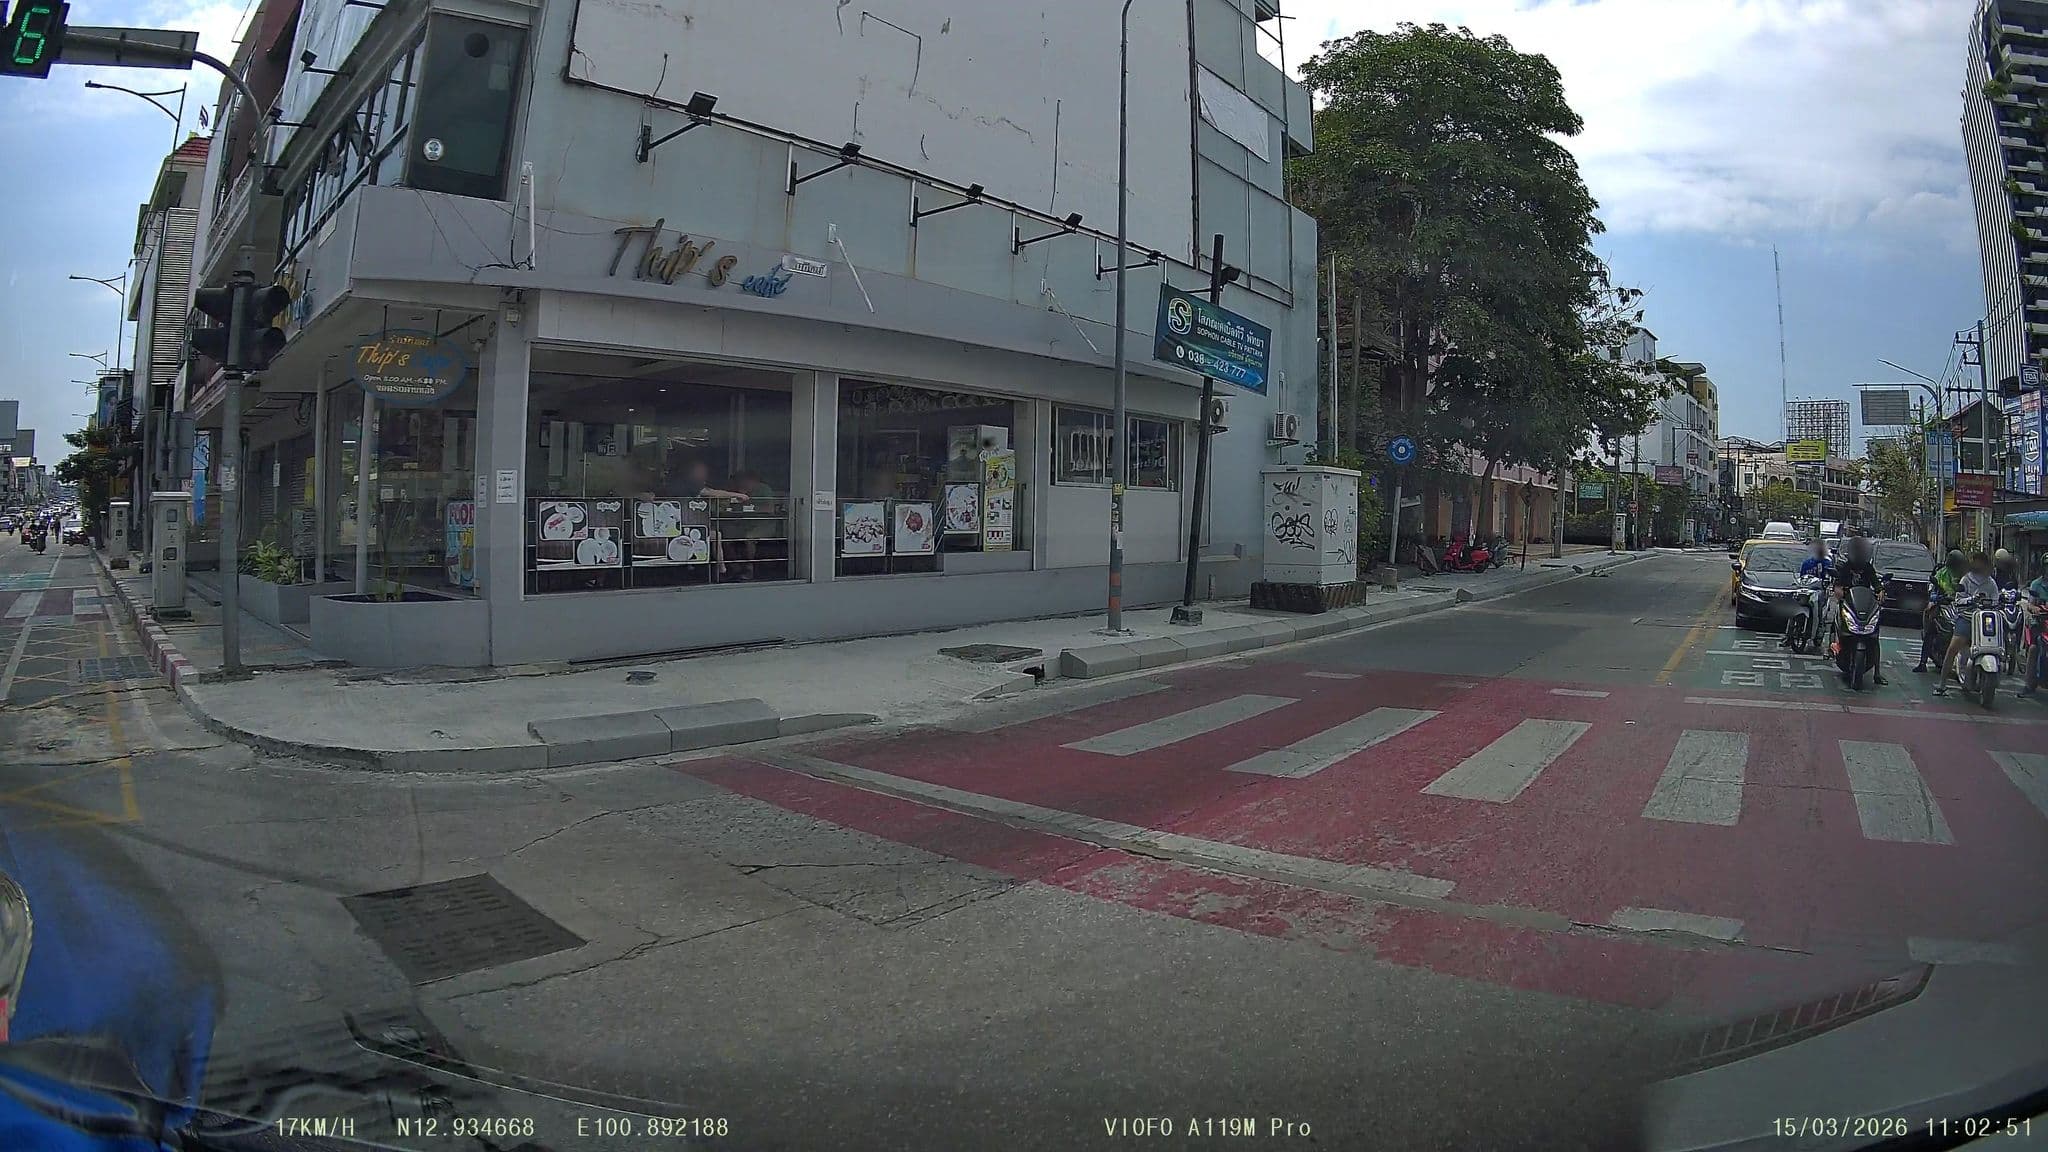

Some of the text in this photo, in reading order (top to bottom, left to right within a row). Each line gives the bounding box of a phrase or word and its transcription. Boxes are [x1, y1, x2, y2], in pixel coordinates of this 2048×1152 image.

[13, 7, 50, 64] 6
[357, 342, 411, 374] Thip's
[1196, 327, 1220, 341] SOPHON
[1219, 335, 1237, 349] CABLE
[1236, 341, 1245, 351] TV
[1243, 344, 1264, 359] PATTAYA
[1230, 363, 1247, 379] 777
